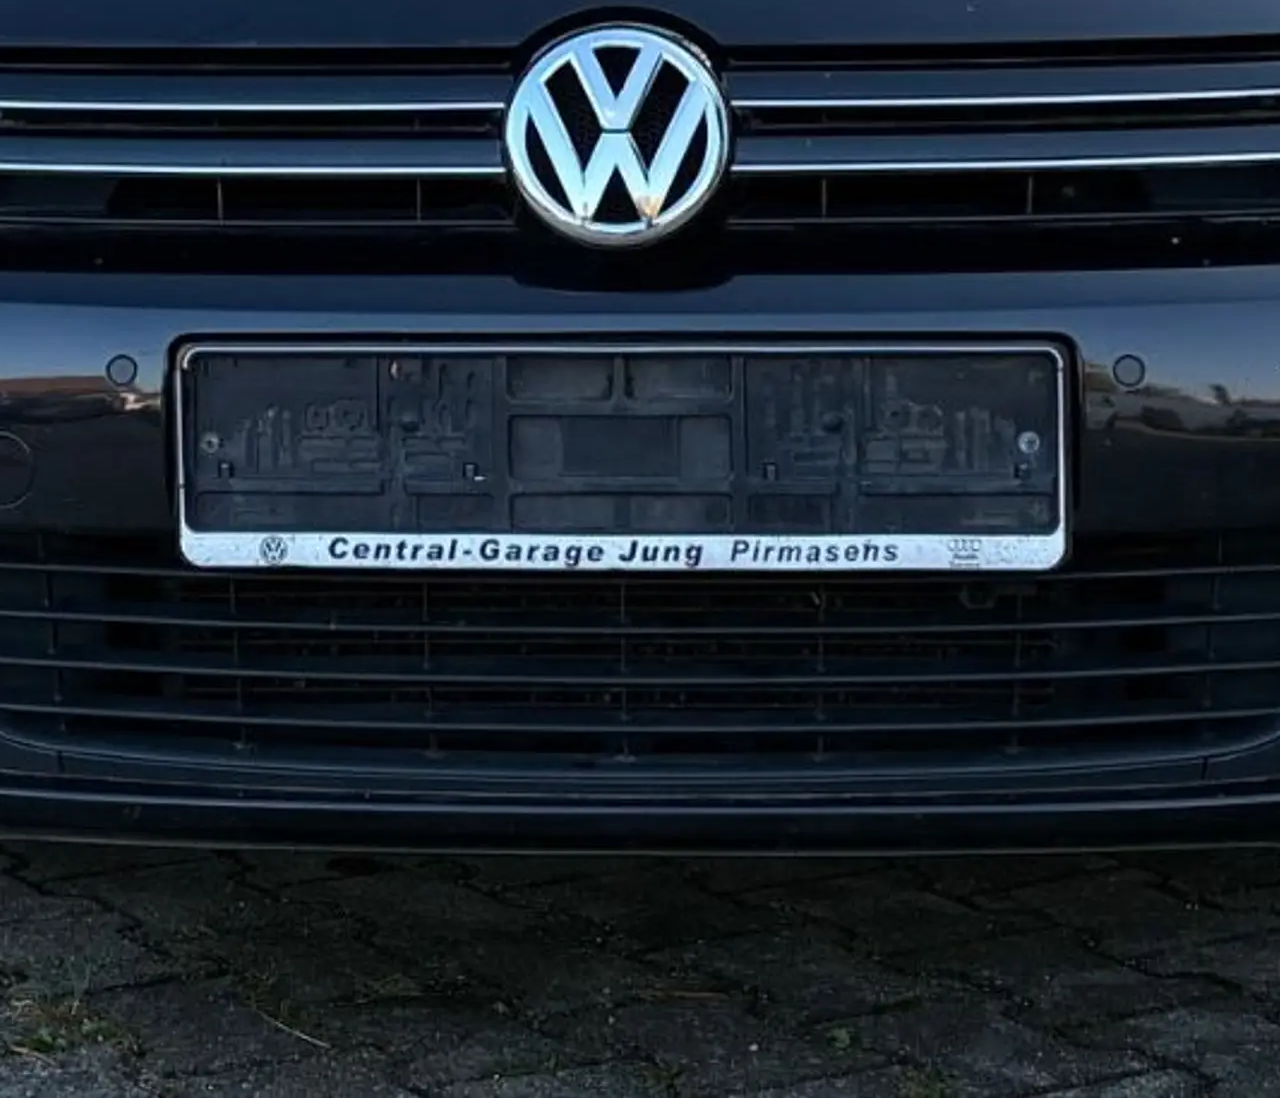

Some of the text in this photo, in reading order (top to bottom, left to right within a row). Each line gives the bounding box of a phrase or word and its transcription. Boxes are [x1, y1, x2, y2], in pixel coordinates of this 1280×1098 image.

[507, 23, 727, 245] VW
[328, 537, 605, 567] Central-Garage
[619, 540, 703, 567] Jung
